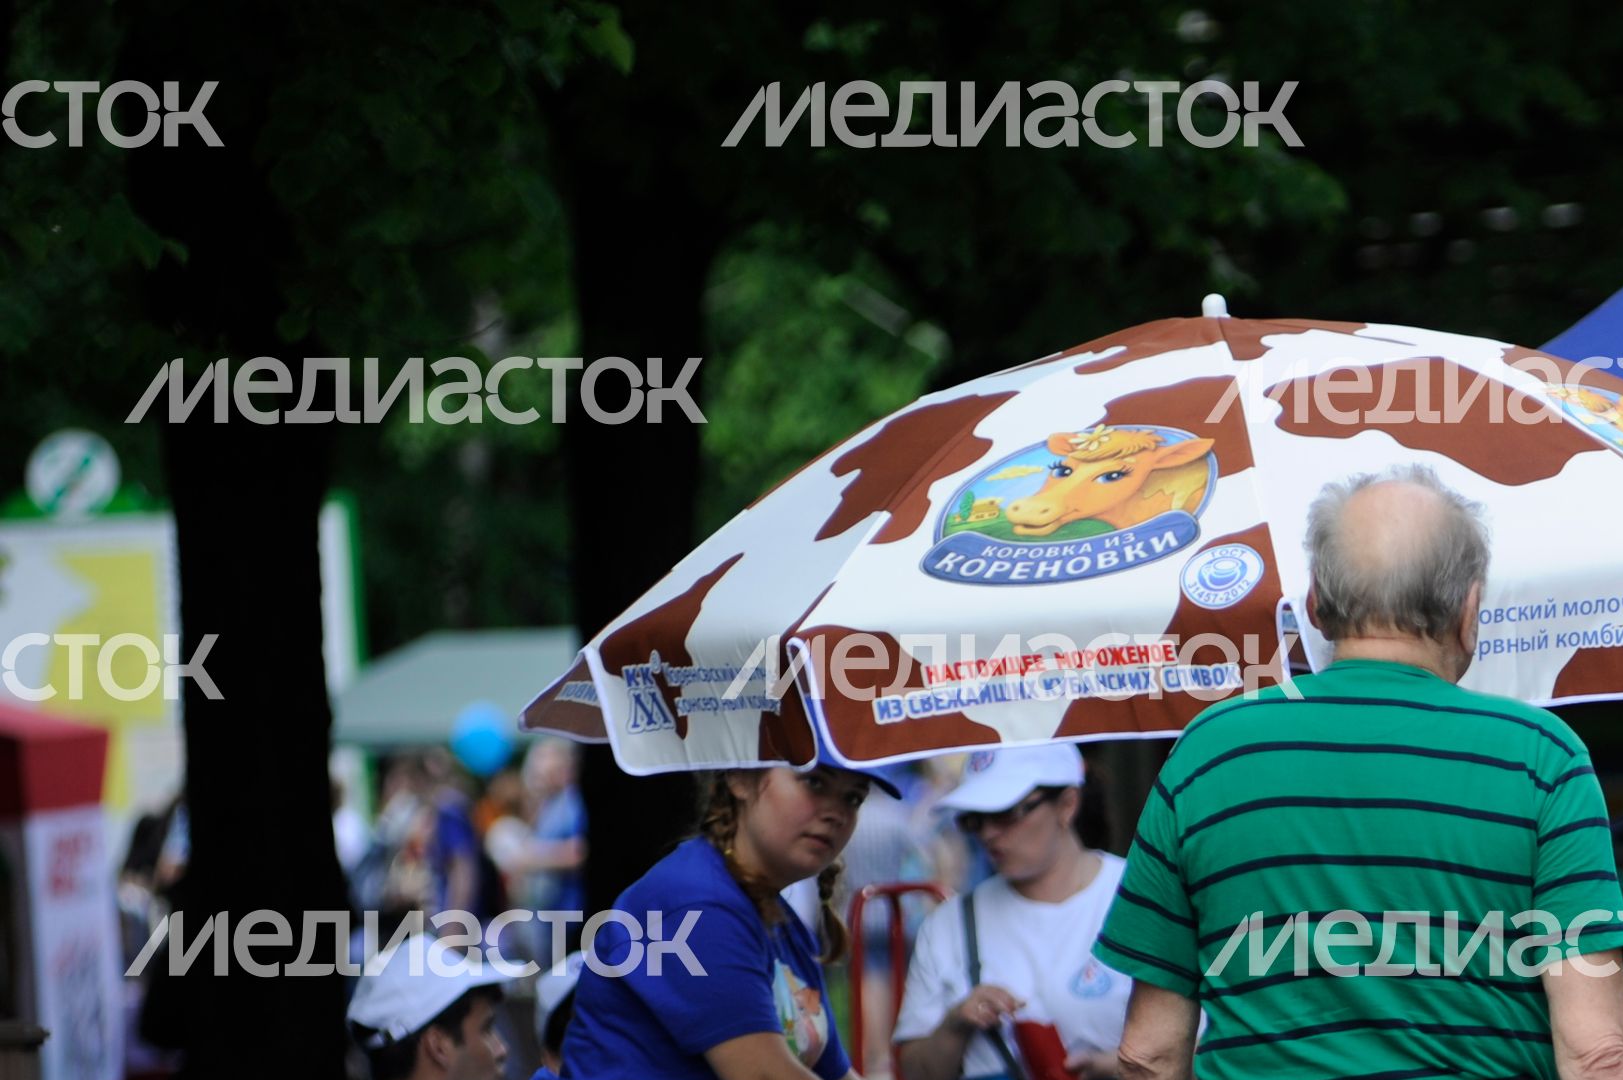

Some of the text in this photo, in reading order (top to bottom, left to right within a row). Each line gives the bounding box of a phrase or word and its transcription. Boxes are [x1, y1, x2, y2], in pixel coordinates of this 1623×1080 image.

[935, 530, 1179, 581] КОРЕНОВКИ
[982, 531, 1136, 559] КОРОВКА ИЗ
[1209, 546, 1248, 560] ГОСТ
[1479, 601, 1558, 626] овский
[1478, 628, 1549, 661] рвный
[925, 643, 1176, 684] НАСТОЯЩЕЕ МОРОЖЕНОЕ
[878, 663, 1241, 721] ИЗ СВЕЖАЙШИХ КУБАНСКИХ СЛИВОК
